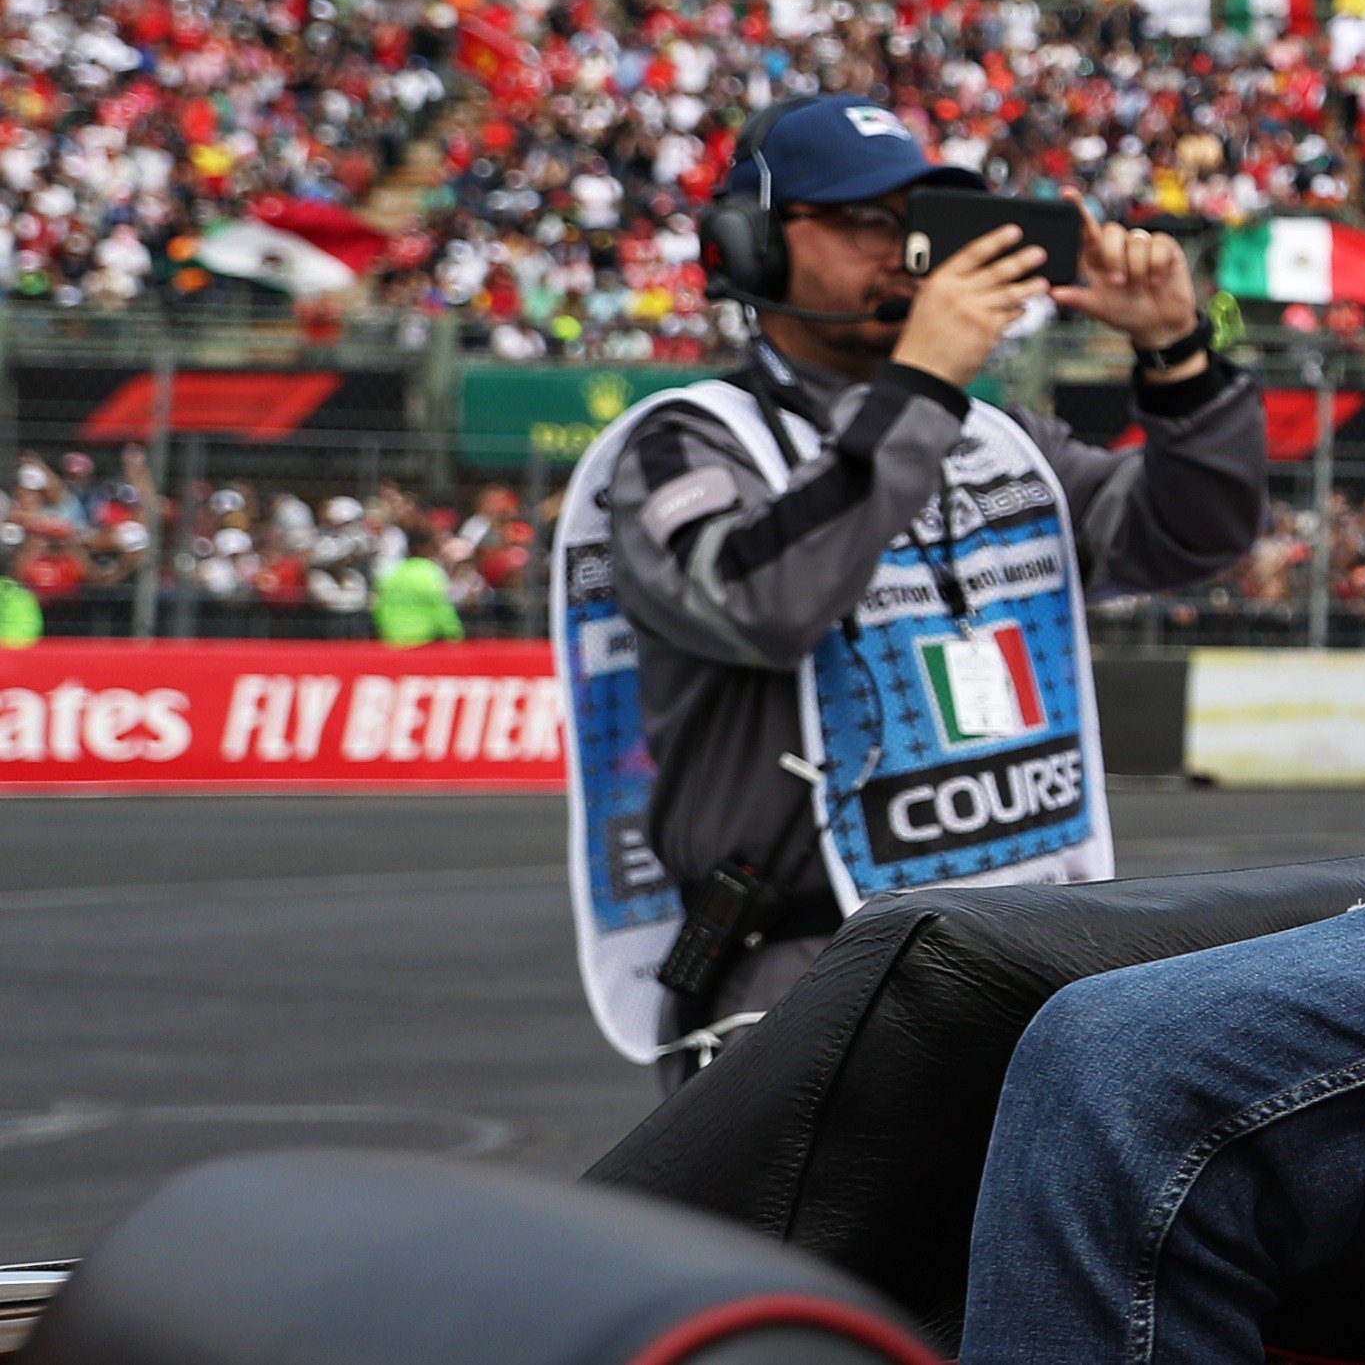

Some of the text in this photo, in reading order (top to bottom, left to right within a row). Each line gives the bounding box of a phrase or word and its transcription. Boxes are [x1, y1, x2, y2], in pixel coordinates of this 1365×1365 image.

[220, 673, 341, 762] FLY
[341, 674, 563, 762] BETTER
[887, 748, 1082, 843] COURSE
